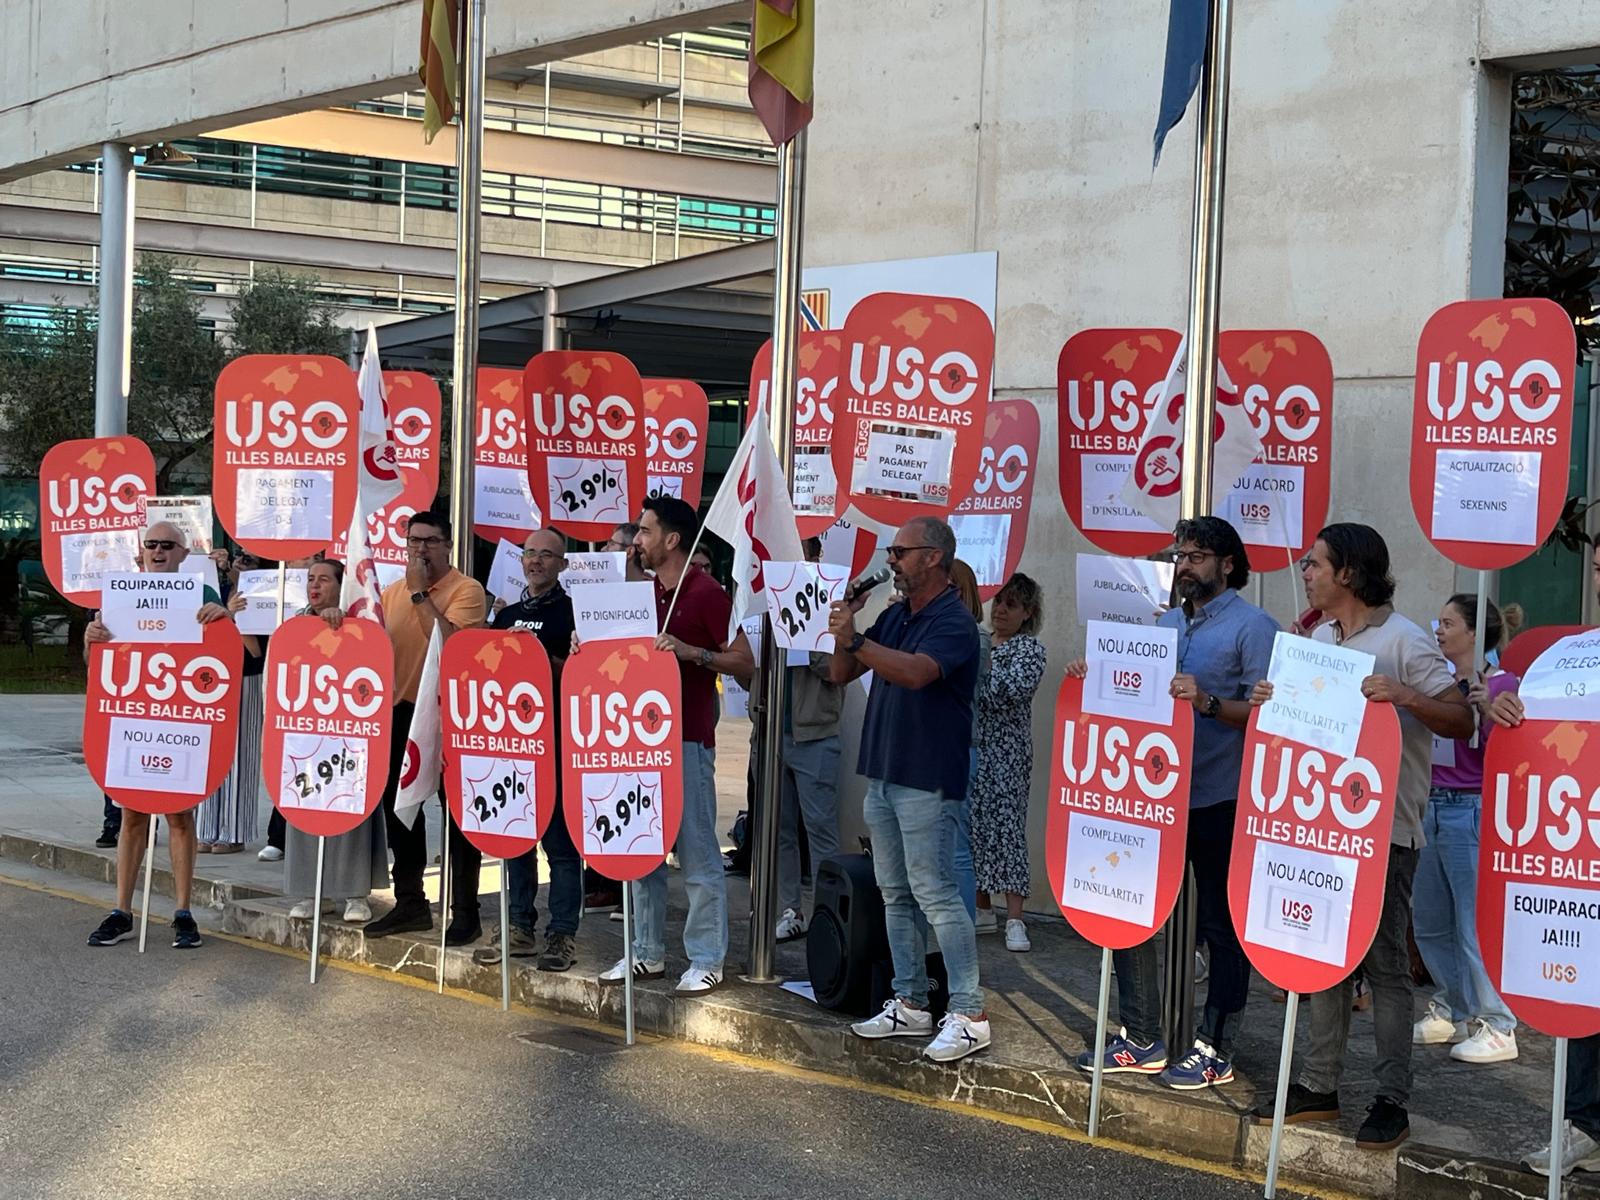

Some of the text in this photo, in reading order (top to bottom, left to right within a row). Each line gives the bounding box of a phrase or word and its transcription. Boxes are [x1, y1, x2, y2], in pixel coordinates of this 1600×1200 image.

[850, 342, 978, 405] USO
[1427, 359, 1561, 423] USO
[532, 393, 636, 440] USO
[847, 398, 892, 417] ILLES
[896, 403, 973, 426] BALEARS
[1244, 384, 1320, 442] SO
[225, 400, 348, 449] USO
[795, 428, 833, 442] BALE
[1426, 425, 1557, 445] ILLES BALEARS
[535, 439, 636, 457] ILLES BALEARS
[644, 417, 698, 459] SO
[1070, 434, 1112, 450] ILLES
[226, 451, 347, 466] ILLES BALEARS
[396, 447, 430, 459] EARS
[498, 452, 528, 467] BALE
[895, 444, 914, 455] PAS
[646, 460, 694, 473] ALEARS
[879, 456, 928, 469] PAGAMENT
[973, 445, 1028, 494] SO
[1095, 463, 1131, 473] COMPL
[1449, 460, 1524, 474] ACTUALITZACIÓ
[255, 478, 315, 489] PAGAMENT
[795, 474, 820, 483] AMENT
[881, 469, 922, 481] DELEGAT
[1253, 478, 1296, 493] ACORD
[48, 473, 147, 518] USO
[562, 468, 617, 513] 2,9%
[813, 495, 835, 505] USO
[922, 484, 947, 496] USO
[260, 496, 310, 507] DELEGAT
[973, 496, 1023, 510] BALEARS
[1241, 503, 1271, 518] USO
[1460, 500, 1508, 512] SEXENNIS
[51, 514, 139, 532] ILLES BALEAR
[372, 547, 410, 562] ALEAR
[110, 577, 195, 592] EQUIPARACIÓ
[136, 597, 168, 609] JA!!!!
[781, 576, 829, 638] 2,9%
[581, 606, 650, 622] FP DIGNIFICACIÓ
[137, 619, 167, 631] USO
[1097, 638, 1168, 659] NOU ACORD
[1286, 646, 1356, 675] COMPLEMENT
[100, 649, 231, 705] USO
[1113, 670, 1142, 688] USO
[276, 662, 384, 719] USO
[1565, 682, 1586, 697] 0-3
[99, 699, 226, 722] ILLES BALEARS
[448, 678, 545, 736] USO
[275, 715, 381, 737] ILLES BALEARS
[570, 689, 673, 748] USO
[1271, 702, 1349, 734] D'INSULARITAT
[123, 730, 200, 747] NOU ACORD
[451, 733, 545, 756] ILLES BALEARS
[141, 754, 173, 769] USO
[572, 750, 672, 769] ILLES BALEARS
[1062, 719, 1180, 799] USO
[295, 747, 356, 798] 2,9%
[474, 770, 525, 823] 2,9%
[1250, 743, 1383, 830] USO
[596, 783, 651, 844] 2,9%
[1060, 787, 1176, 826] ILLES BALEARS
[1494, 772, 1600, 852] US
[1081, 825, 1145, 849] COMPLEMENT
[1246, 815, 1375, 858] ILLES BALEARS
[1493, 850, 1600, 882] ILLES BALE
[1267, 861, 1344, 893] NOU ACORD
[1073, 877, 1145, 905] D'INSULARITAT
[1281, 898, 1313, 922] USO
[1541, 928, 1580, 949] JA!!!!
[1542, 962, 1577, 983] USO
